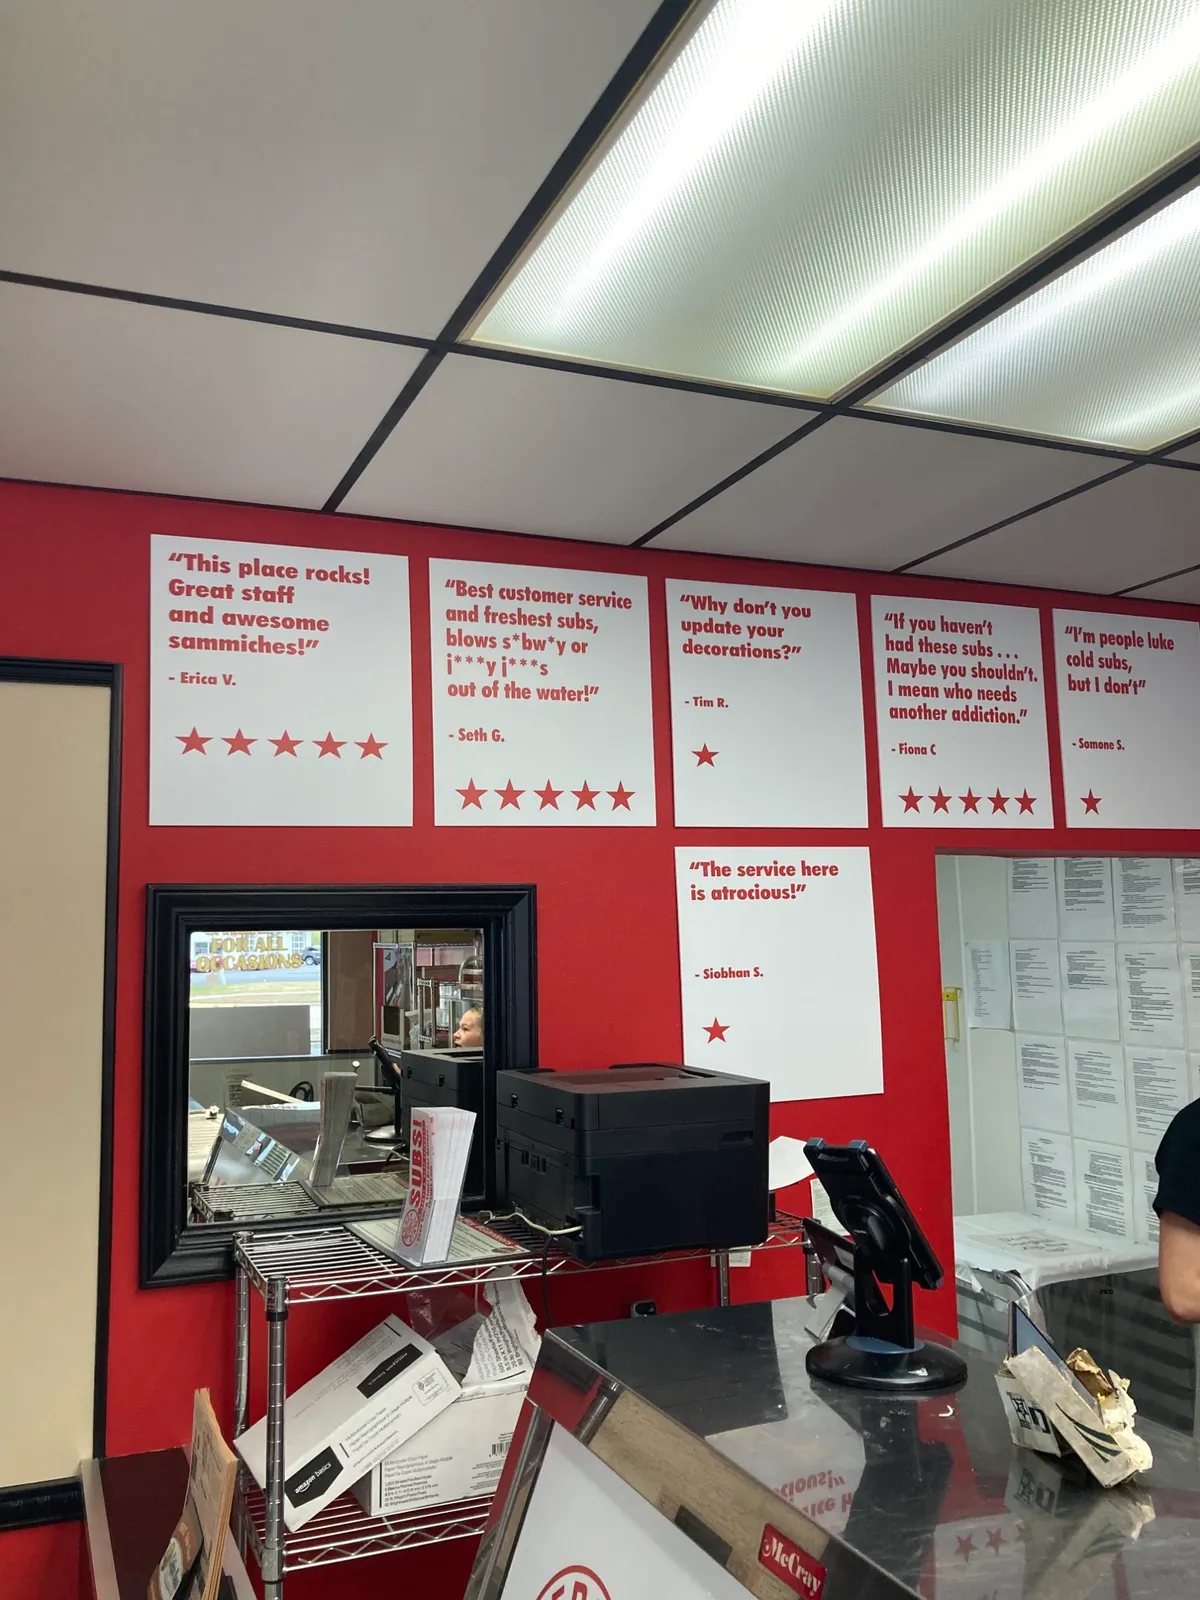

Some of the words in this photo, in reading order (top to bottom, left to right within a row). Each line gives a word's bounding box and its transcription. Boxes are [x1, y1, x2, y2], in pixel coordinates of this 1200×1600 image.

[170, 553, 230, 574] “This
[239, 558, 298, 578] place
[305, 566, 369, 584] rocks!
[168, 578, 234, 600] Great
[242, 585, 294, 603] staff
[446, 580, 493, 598] “Best
[498, 587, 573, 604] customer
[579, 592, 631, 608] service
[681, 595, 727, 614] “Why
[734, 598, 776, 615] don’t
[782, 606, 811, 620] you
[168, 606, 214, 624] and
[221, 613, 329, 632] awesome
[446, 605, 479, 623] and
[484, 606, 552, 626] freshest
[557, 612, 598, 633] subs,
[682, 618, 741, 637] update
[748, 626, 784, 638] your
[885, 614, 904, 629] “If
[909, 620, 936, 634] you
[940, 617, 992, 634] haven’t
[169, 634, 318, 655] sammiches!”
[446, 628, 497, 648] blows
[572, 642, 587, 653] or
[886, 636, 913, 652] had
[919, 637, 956, 654] these
[962, 644, 992, 656] subs
[1066, 627, 1095, 644] “I’m
[1100, 634, 1143, 649] people
[1148, 636, 1173, 649] luke
[682, 639, 801, 659] decorations?”
[887, 658, 936, 678] Maybe
[942, 665, 966, 680] you
[972, 662, 1037, 681] shouldn’t.
[1066, 652, 1093, 668] cold
[1098, 654, 1131, 673] subs,
[180, 672, 218, 685] Erica
[223, 675, 235, 685] V.
[1068, 675, 1090, 691] but
[1095, 678, 1100, 691] I
[1104, 679, 1145, 694] don’t”
[448, 683, 476, 698] out
[482, 680, 499, 698] of
[504, 682, 531, 699] the
[537, 685, 598, 702] water!”
[888, 681, 893, 696] I
[898, 686, 938, 699] mean
[944, 684, 973, 699] who
[977, 687, 1017, 702] needs
[694, 696, 713, 706] Tim
[717, 698, 727, 707] R.
[890, 704, 947, 720] another
[952, 705, 1027, 723] addiction.”
[458, 729, 487, 742] Seth
[491, 729, 504, 742] G.
[1080, 739, 1113, 749] Somone
[899, 743, 927, 755] Fiona
[931, 745, 935, 755] C
[690, 861, 732, 877] “The
[738, 861, 795, 877] service
[801, 860, 838, 876] here
[691, 884, 705, 901] is
[711, 883, 806, 900] atrocious!”
[210, 937, 249, 953] FOR
[255, 936, 288, 951] ALL
[196, 952, 304, 972] OCCASIONS
[703, 968, 750, 979] Siobhan
[753, 967, 762, 977] S.
[410, 1119, 423, 1208] SUBS!
[295, 1475, 316, 1494] amazon
[314, 1462, 332, 1477] basics
[762, 1537, 821, 1594] McCray
